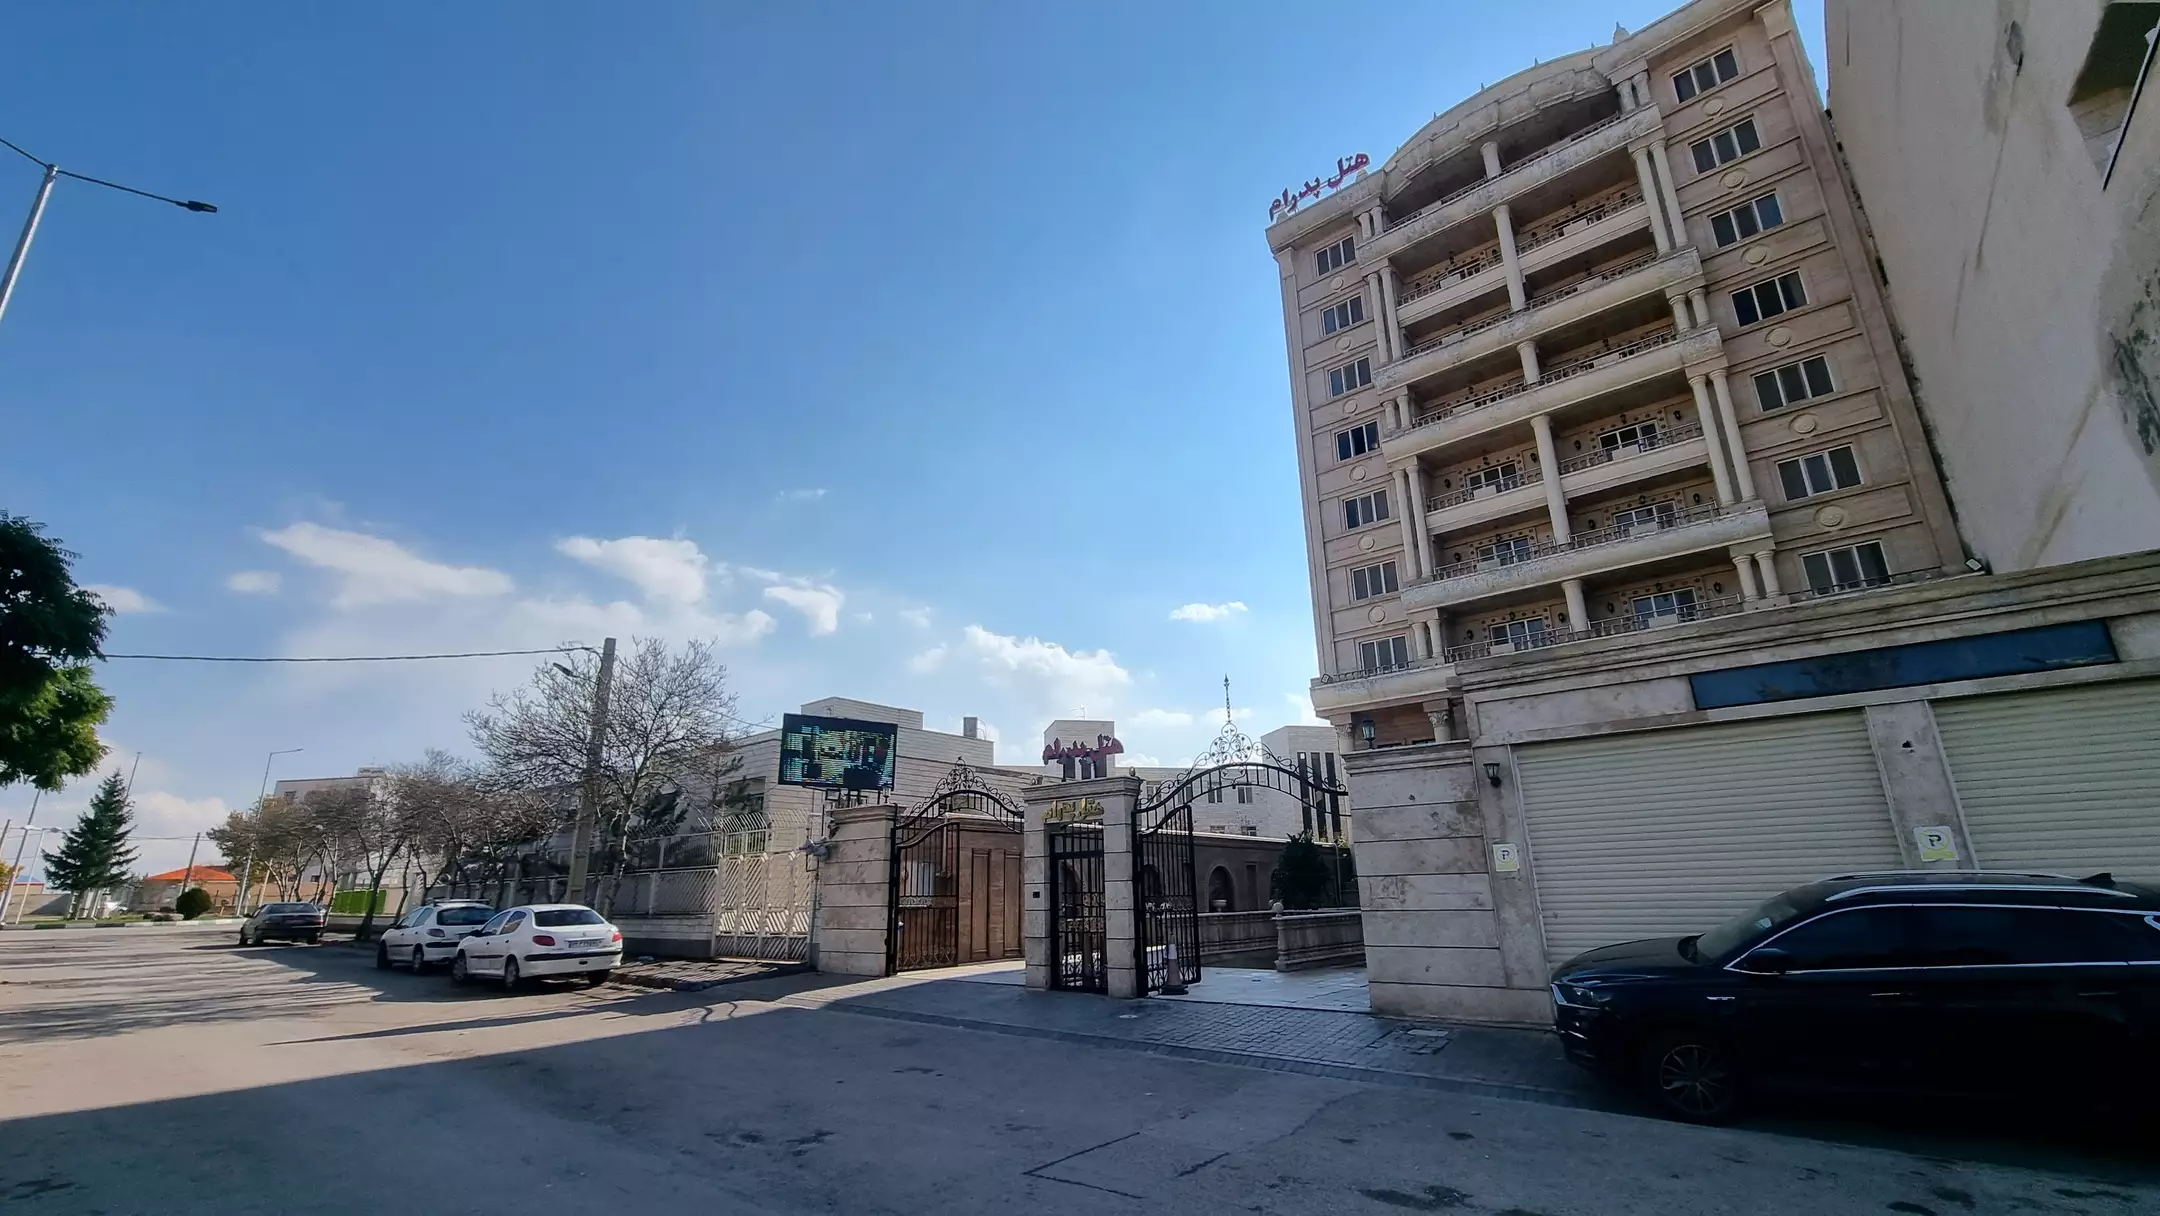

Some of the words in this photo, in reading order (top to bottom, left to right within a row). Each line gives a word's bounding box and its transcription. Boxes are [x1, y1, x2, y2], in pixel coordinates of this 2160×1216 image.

[1327, 152, 1371, 190] هتل
[1268, 176, 1321, 223] پدرام
[1088, 733, 1124, 762] هتل
[1078, 797, 1105, 821] هتل
